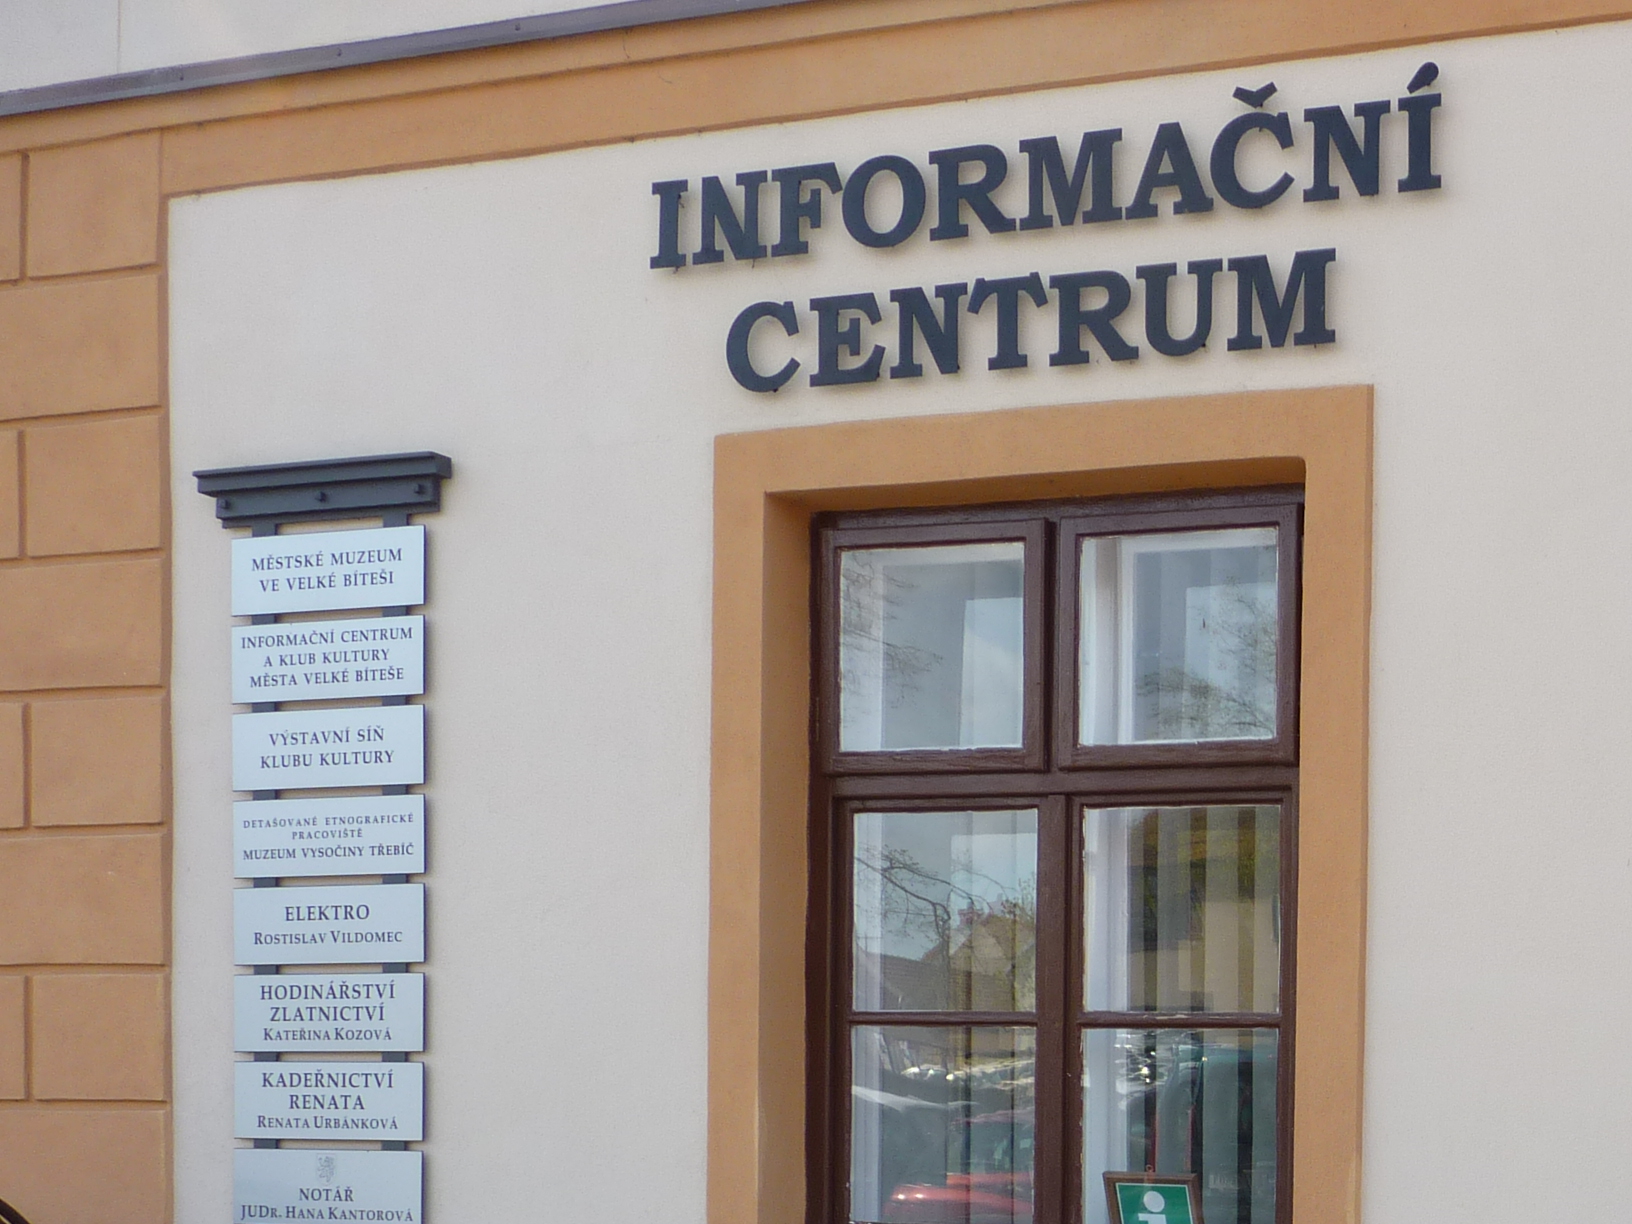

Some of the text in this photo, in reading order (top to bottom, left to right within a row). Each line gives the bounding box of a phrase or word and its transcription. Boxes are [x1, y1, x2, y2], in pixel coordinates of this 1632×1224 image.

[649, 61, 1442, 270] INFORMAČNÍ
[726, 247, 1336, 393] CENTRUM
[252, 548, 402, 571] MĚSTSKÉ MUZEUM
[259, 569, 394, 592] VE VELKÉ BÍTEŠI
[241, 627, 412, 649] INFORMAČNÍ CENTRUM
[263, 649, 390, 667] A KLUB KULTURY
[250, 665, 404, 688] MĚSTA VELKÉ BÍTEŠE
[269, 725, 384, 746] VÝSTAVNÍ SÍŇ
[260, 750, 394, 769] KLUBU KULTURY
[243, 812, 414, 829] DETAŠOVANÉ ETNOGRAFICKÉ
[243, 842, 415, 860] MUZEUM VYSOČINY TŘEBÍČ
[285, 904, 370, 921] ELEKTRO
[260, 980, 396, 1000] HODINÁŘSTVÍ
[270, 1002, 385, 1022] ZLATNICTVÍ
[262, 1069, 394, 1088] KADEŘNICTVÍ
[289, 1094, 365, 1110] RENATA
[299, 1186, 354, 1202] NOTÁŘ
